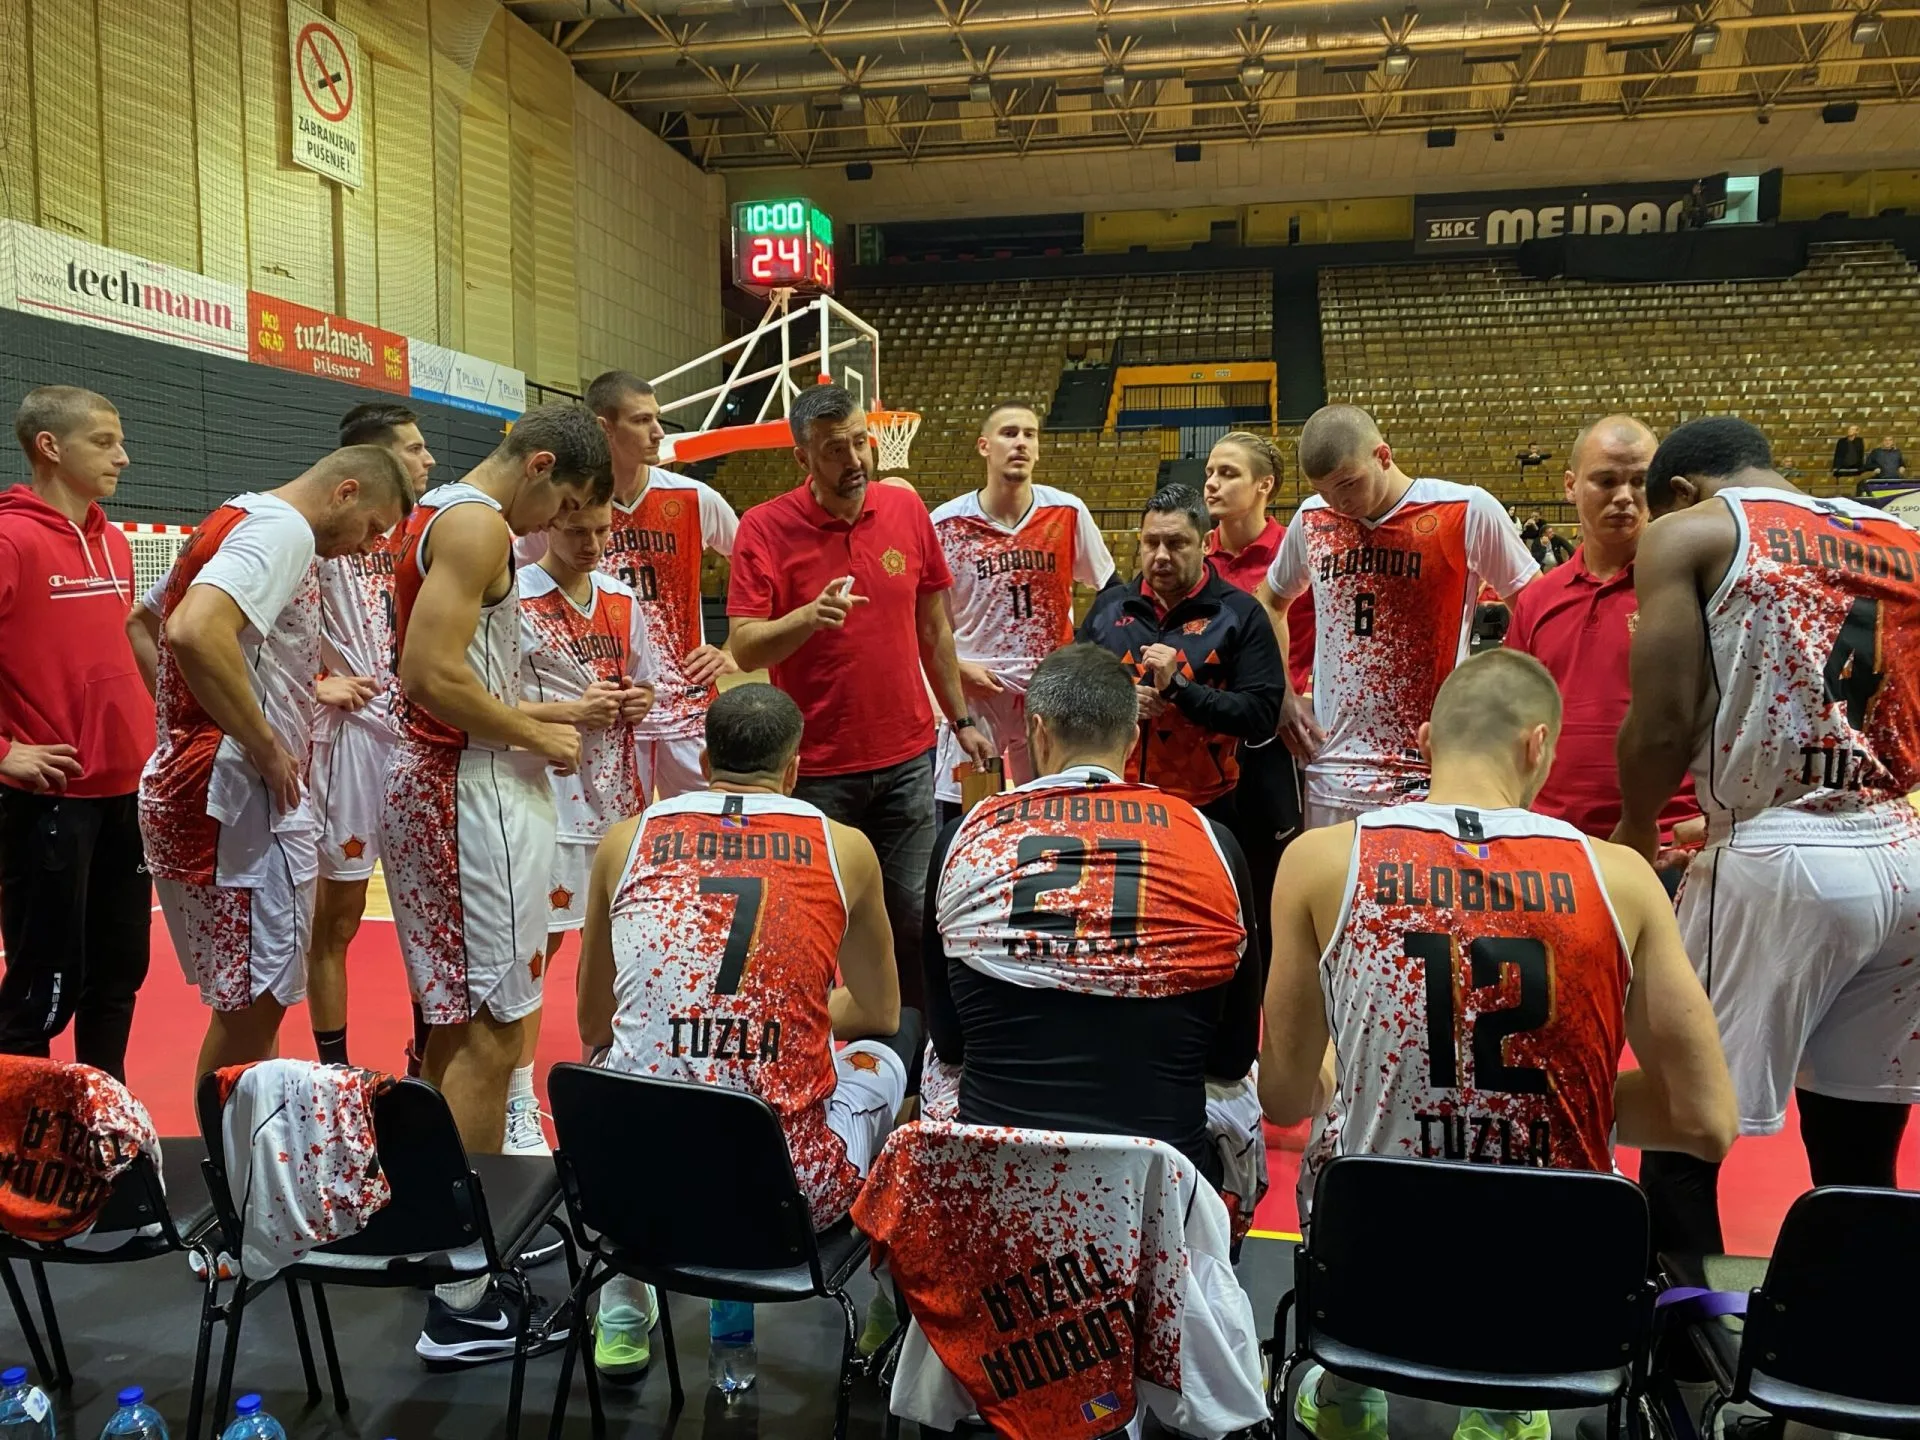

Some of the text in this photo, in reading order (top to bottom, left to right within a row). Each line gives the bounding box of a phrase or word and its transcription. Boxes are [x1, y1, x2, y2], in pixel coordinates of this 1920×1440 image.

[298, 115, 356, 155] ZABRANJENO
[746, 201, 804, 233] 10:00
[1430, 220, 1476, 239] SKPC
[752, 238, 801, 278] 24
[813, 240, 832, 286] 24
[258, 330, 285, 352] GRAD
[294, 315, 375, 366] tuzlanski
[313, 356, 361, 379] pilsner
[462, 371, 486, 389] PLAVA
[503, 383, 524, 398] PLAVA
[604, 528, 677, 558] LOBODA
[1767, 527, 1920, 584] SLOBOD
[976, 549, 1056, 581] SLOBODA
[1320, 547, 1422, 582] SLOBODA
[1008, 583, 1033, 620] 11
[1354, 593, 1376, 637] 6
[1823, 594, 1887, 734] 4
[996, 795, 1169, 829] SLOBODA
[652, 831, 813, 867] SLOBODA
[1008, 835, 1146, 938] 21
[1376, 861, 1577, 914] SLOBODA
[698, 876, 766, 996] 7
[1404, 931, 1555, 1095] 12
[668, 1017, 781, 1062] TUZLA
[1414, 1112, 1551, 1168] TUZLA
[979, 1242, 1118, 1333] TUZLA
[979, 1299, 1136, 1400] LOBODA
